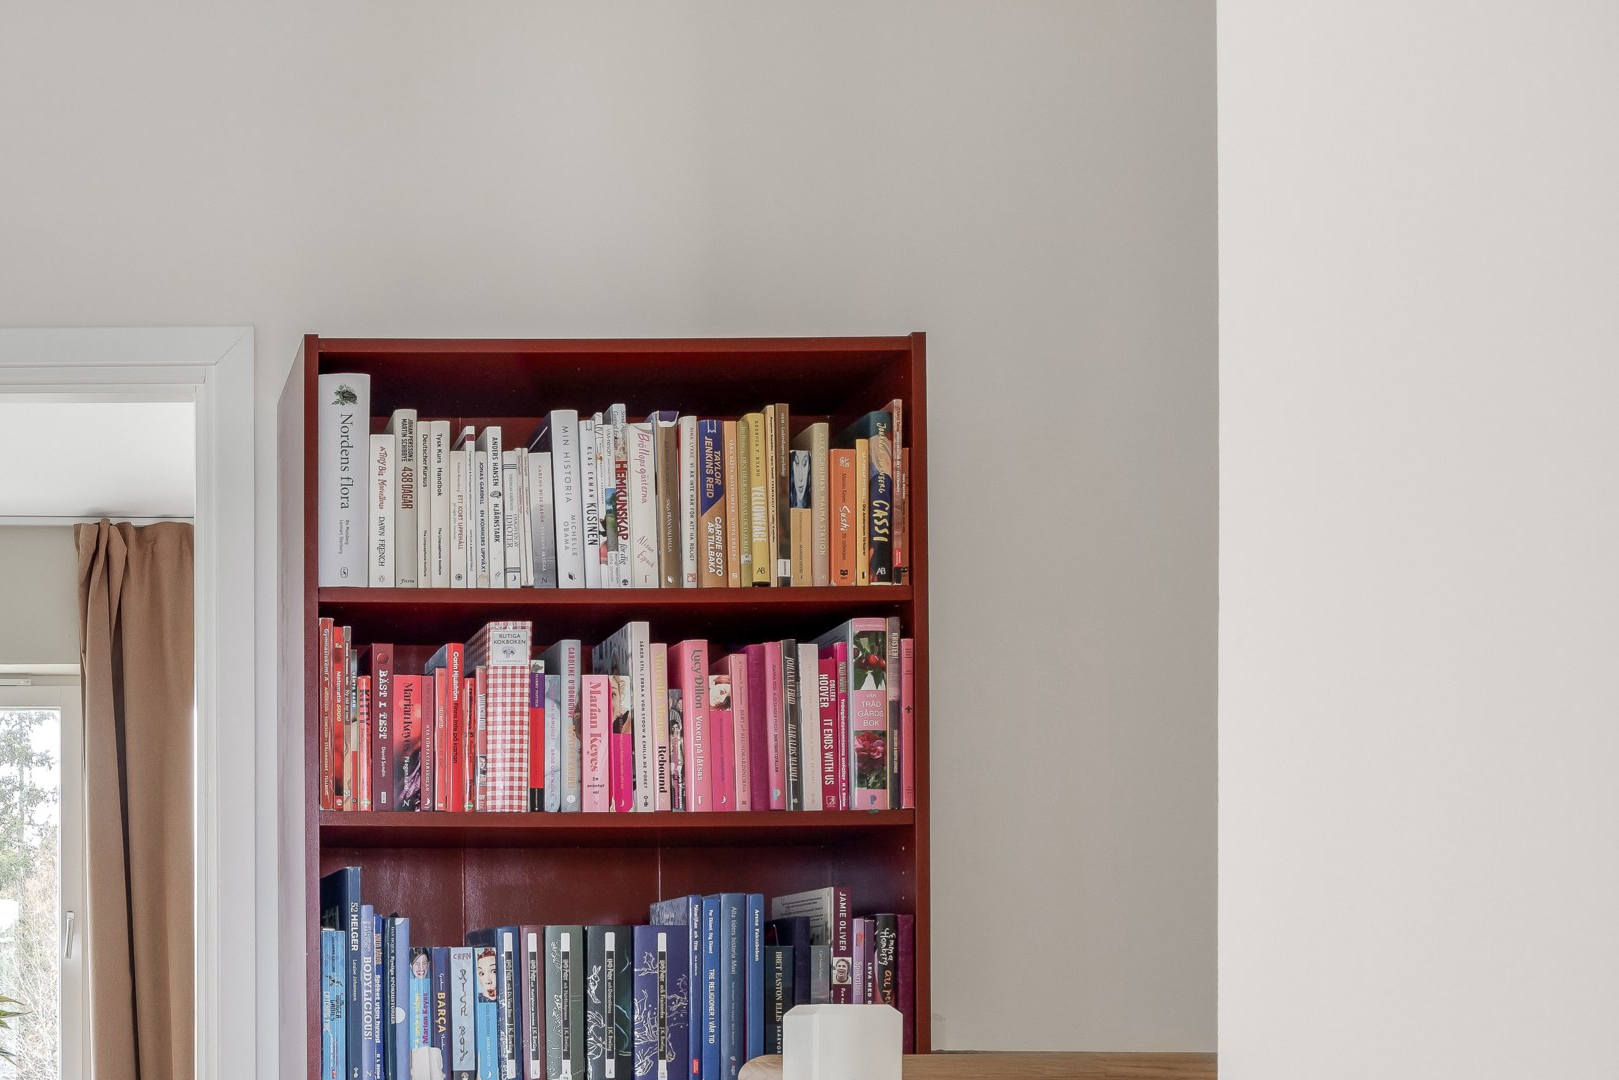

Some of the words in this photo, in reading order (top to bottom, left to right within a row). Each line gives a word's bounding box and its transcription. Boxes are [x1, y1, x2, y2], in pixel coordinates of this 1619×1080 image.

[339, 413, 354, 472] Nordens
[491, 437, 499, 460] ANDERS
[562, 426, 570, 446] MIN
[634, 433, 651, 504] Bröllopsgästerna
[705, 436, 714, 475] JENKINS
[714, 450, 722, 485] TAYLOR
[401, 466, 414, 483] 438
[563, 452, 572, 504] HISTORIA
[706, 477, 714, 499] REID
[339, 476, 354, 510] flora
[401, 485, 414, 510] DAGAR
[615, 461, 629, 541] HEMKUNSKAP
[493, 504, 501, 543] HJÄRNSTARK
[587, 503, 598, 546] KUSINEN
[707, 521, 716, 534] ÄR
[751, 485, 766, 543] YELLOWFACE
[839, 505, 850, 532] Sushi
[873, 500, 890, 543] CASSI
[715, 517, 723, 550] CARRIE
[377, 539, 385, 567] FRENCH
[707, 535, 715, 574] TILLBAKA
[715, 552, 723, 577] SOTO
[691, 649, 703, 673] Lucy
[379, 670, 389, 697] BÄST
[694, 674, 704, 709] Dillon
[819, 674, 829, 708] HOOVER
[403, 682, 413, 719] Marian
[589, 682, 601, 729] Marian
[378, 712, 387, 740] TEST
[823, 728, 833, 750] ENDS
[587, 732, 601, 773] Keyes
[694, 744, 704, 754] på
[824, 752, 834, 772] WITH
[657, 746, 668, 793] Rebound
[696, 756, 704, 781] låtsas
[825, 775, 834, 786] US
[351, 902, 358, 913] 52
[839, 892, 847, 918] JAMIE
[351, 914, 359, 951] HELGER
[839, 920, 847, 951] OLIVER
[888, 932, 896, 961] Emma
[708, 969, 716, 980] TRE
[884, 970, 892, 987] au
[363, 955, 373, 1040] BODYLICIOUS!
[435, 992, 446, 1033] BARÇA
[708, 982, 716, 1016] RELIGIONER
[708, 1021, 717, 1033] VÅR
